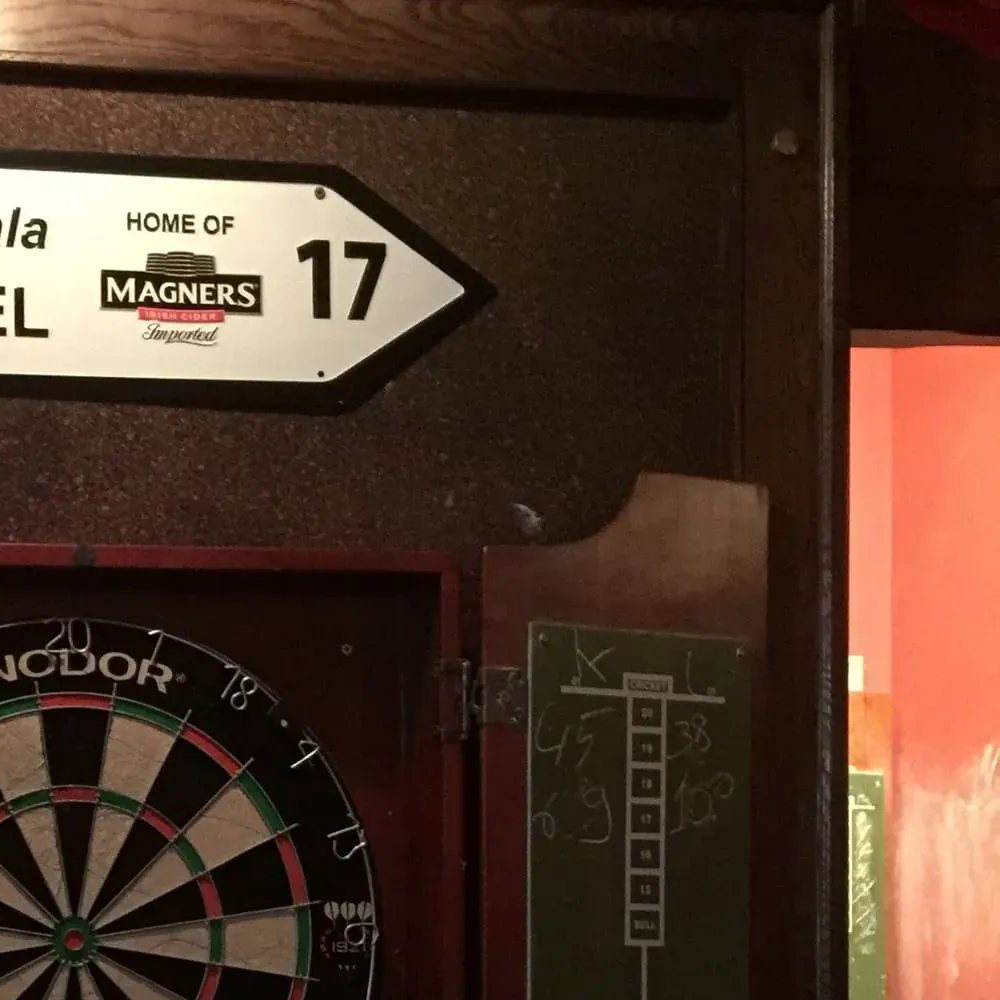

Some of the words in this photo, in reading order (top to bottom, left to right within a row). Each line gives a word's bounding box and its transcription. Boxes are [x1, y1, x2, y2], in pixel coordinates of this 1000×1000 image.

[127, 212, 195, 233] HOME
[203, 215, 235, 235] OF
[296, 239, 387, 320] 17
[106, 276, 257, 308] MAGNERS
[145, 310, 177, 320] IRISH
[180, 312, 217, 321] CIDER
[142, 323, 218, 346] Imported
